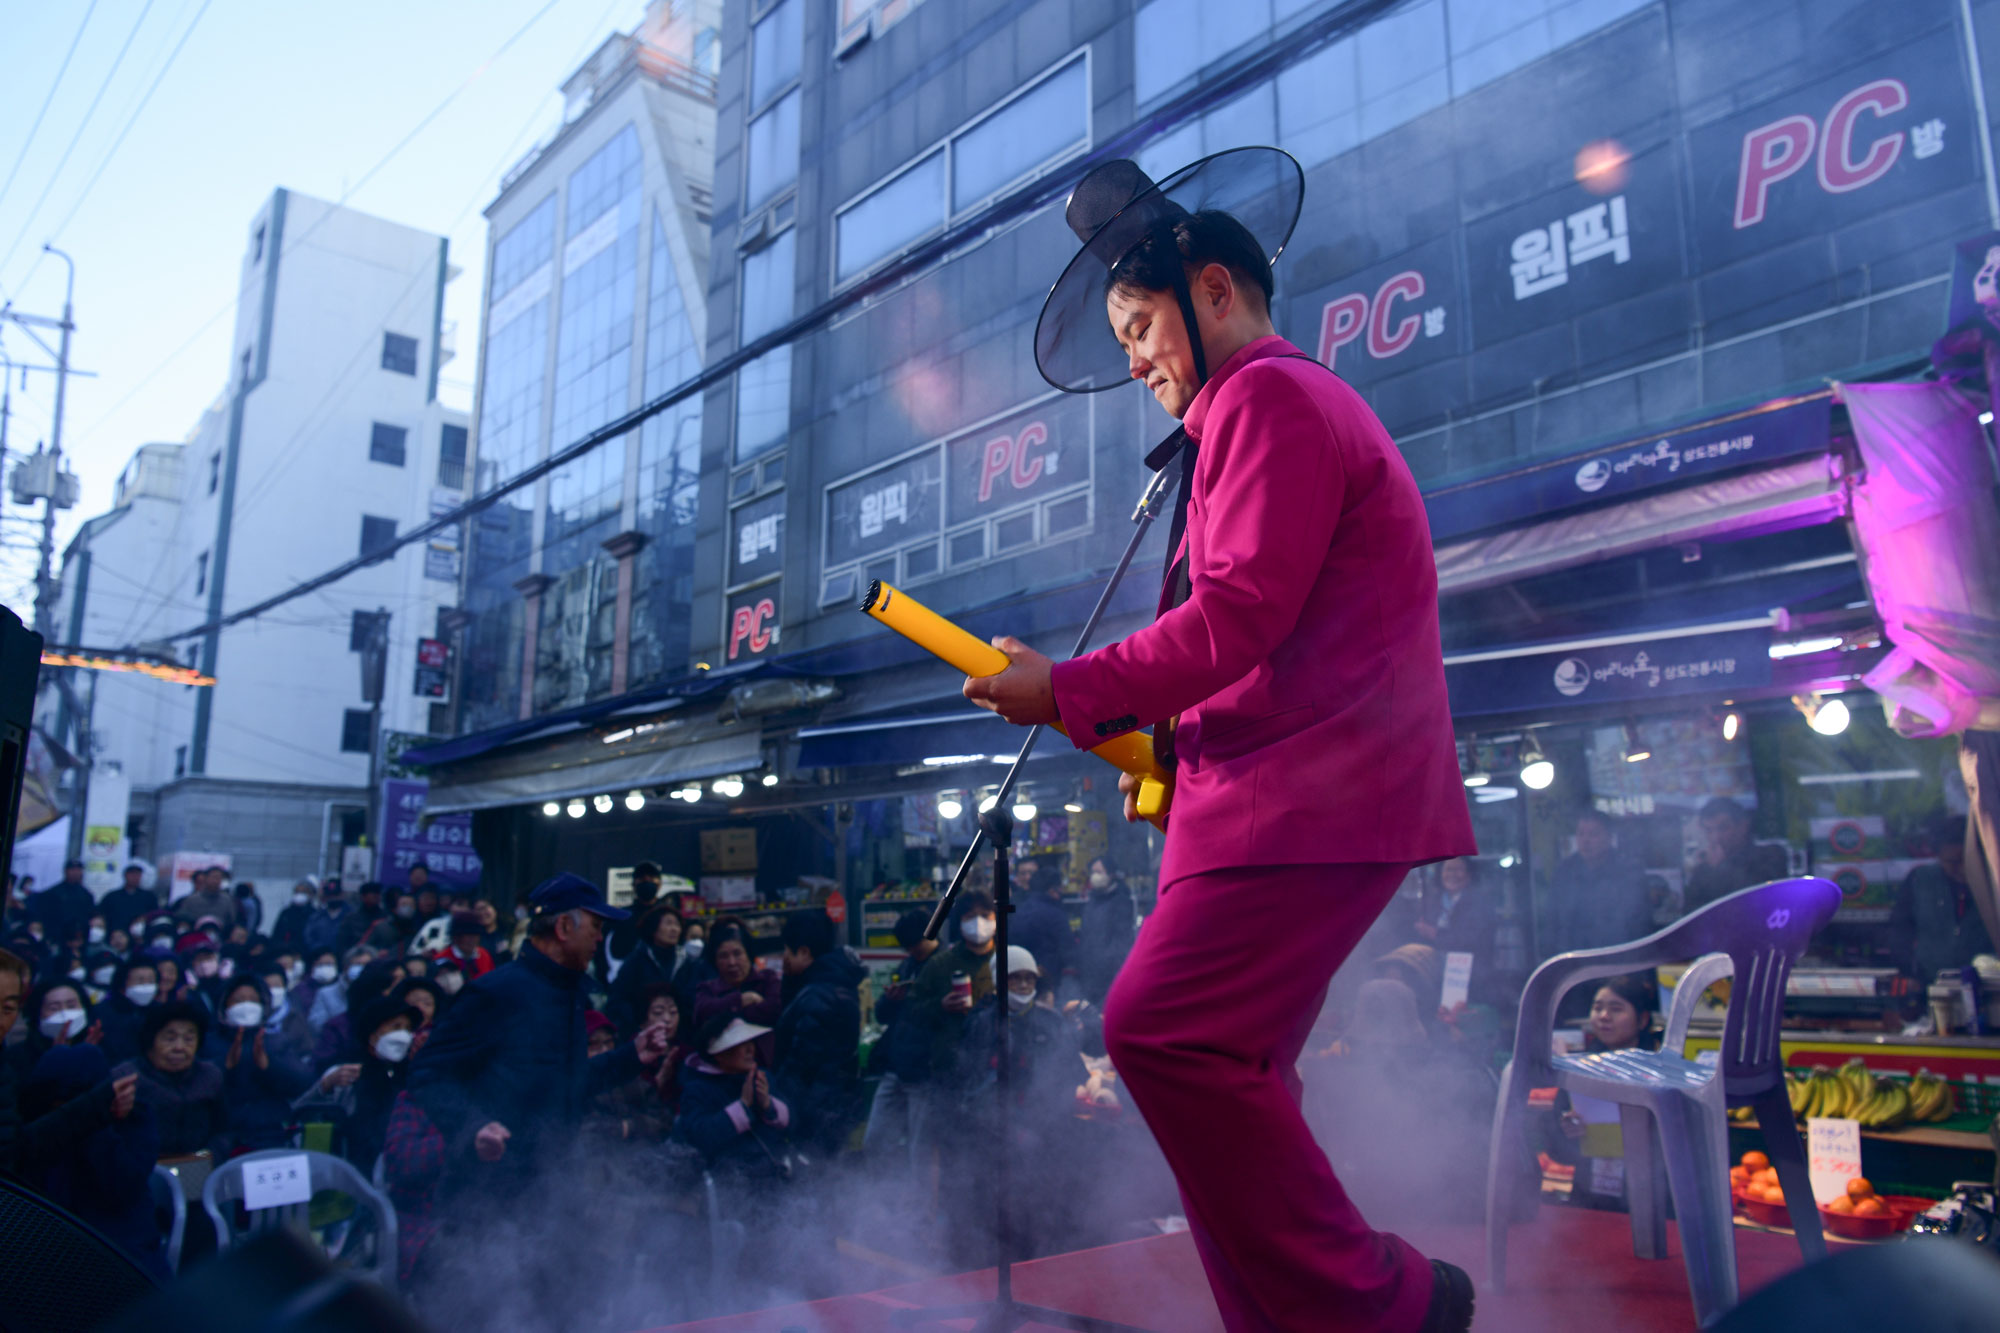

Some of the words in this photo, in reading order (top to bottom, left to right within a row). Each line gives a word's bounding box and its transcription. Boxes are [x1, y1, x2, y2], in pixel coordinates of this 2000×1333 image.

[1509, 195, 1631, 300] 원픽
[860, 481, 908, 538] 원픽
[739, 515, 778, 564] 원픽
